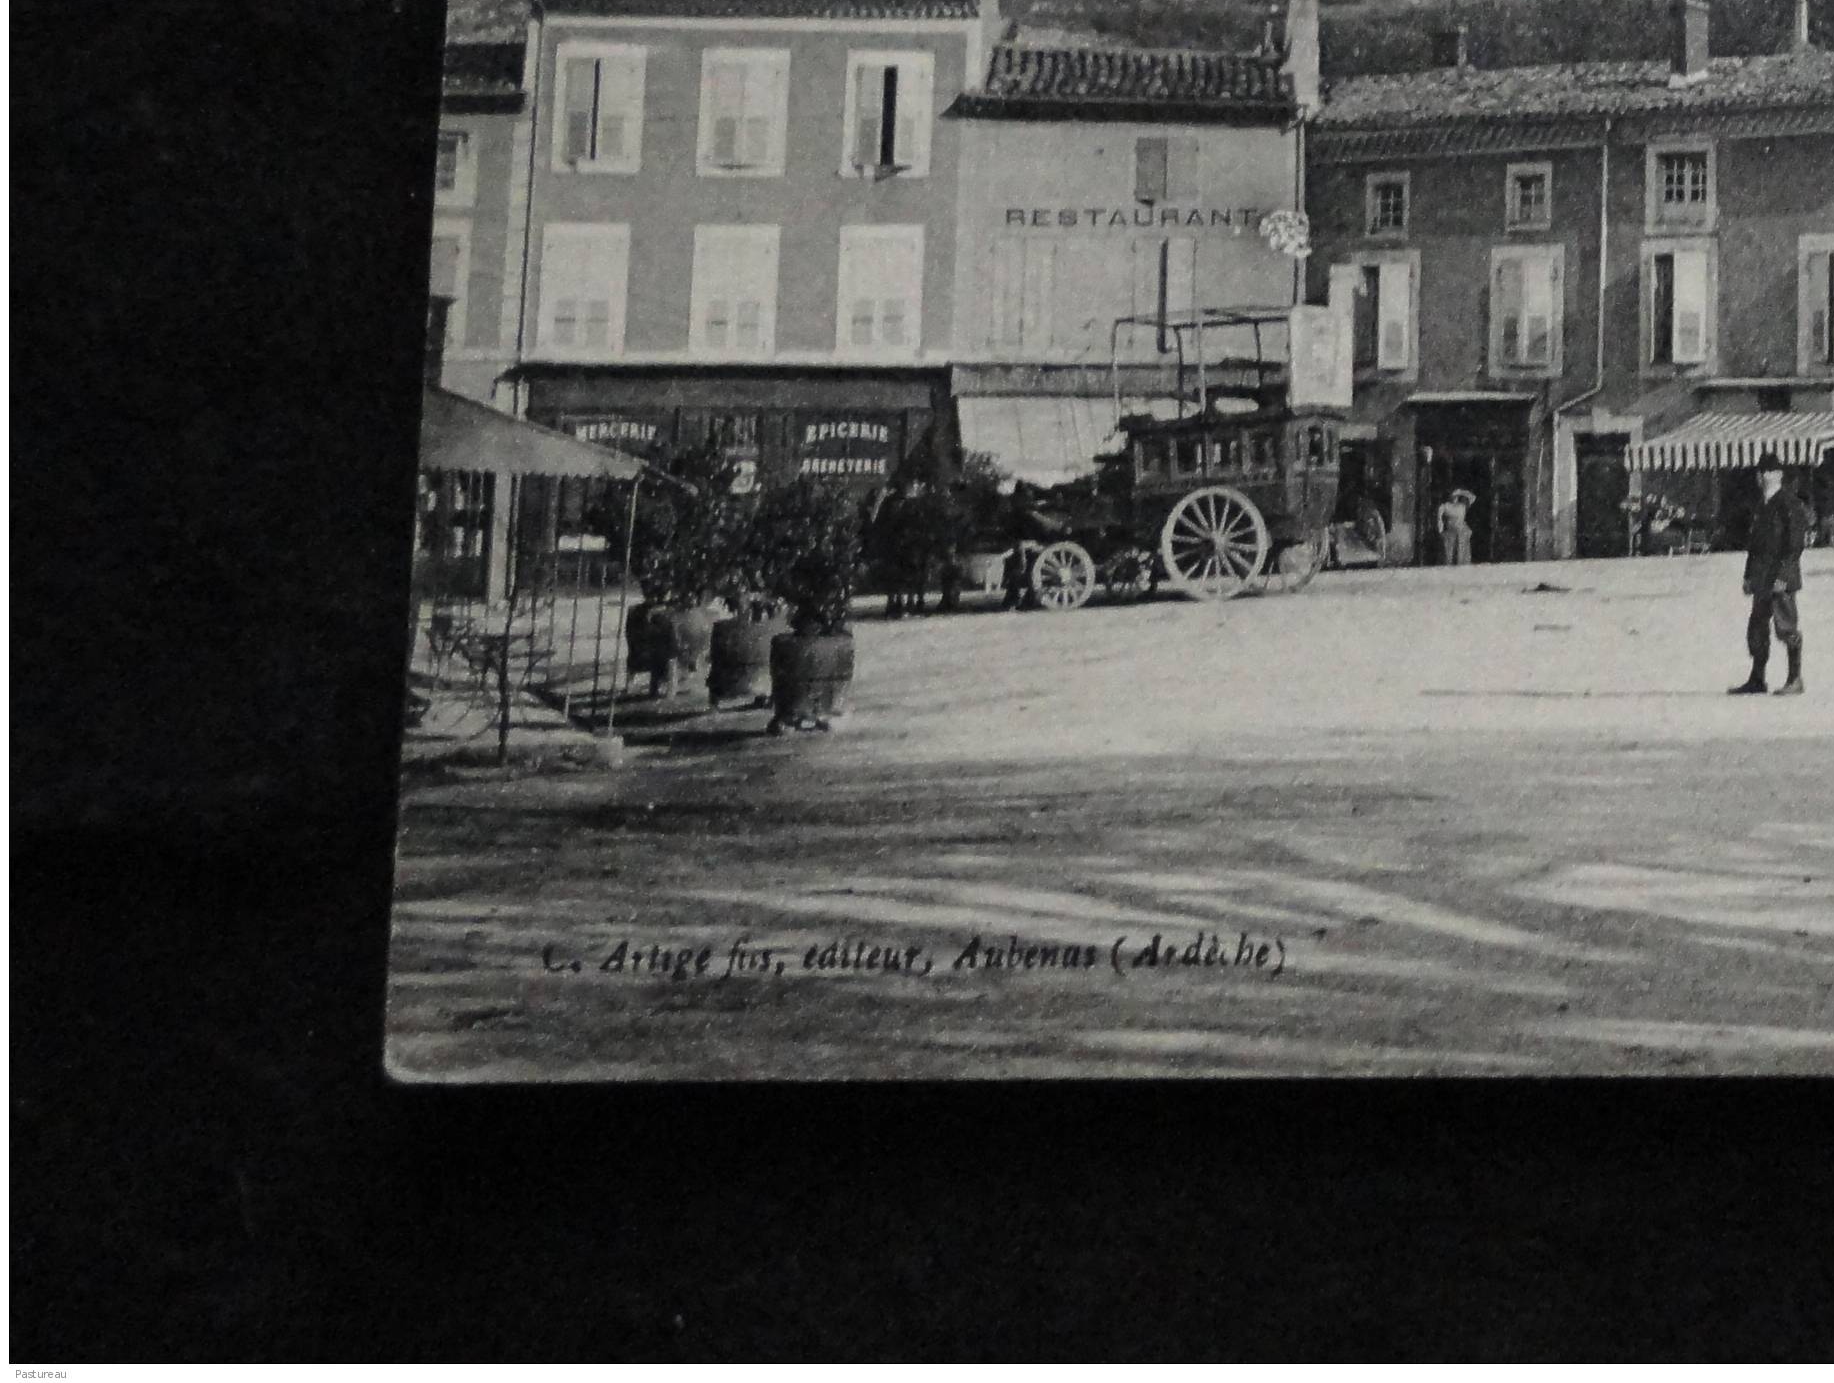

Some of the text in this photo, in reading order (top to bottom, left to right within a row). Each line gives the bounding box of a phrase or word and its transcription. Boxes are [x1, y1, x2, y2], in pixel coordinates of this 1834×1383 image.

[1005, 207, 1261, 228] RESTAURANT
[575, 421, 658, 442] MERCERIE
[804, 420, 889, 445] EPICERIE
[953, 934, 1098, 970] Aubenas
